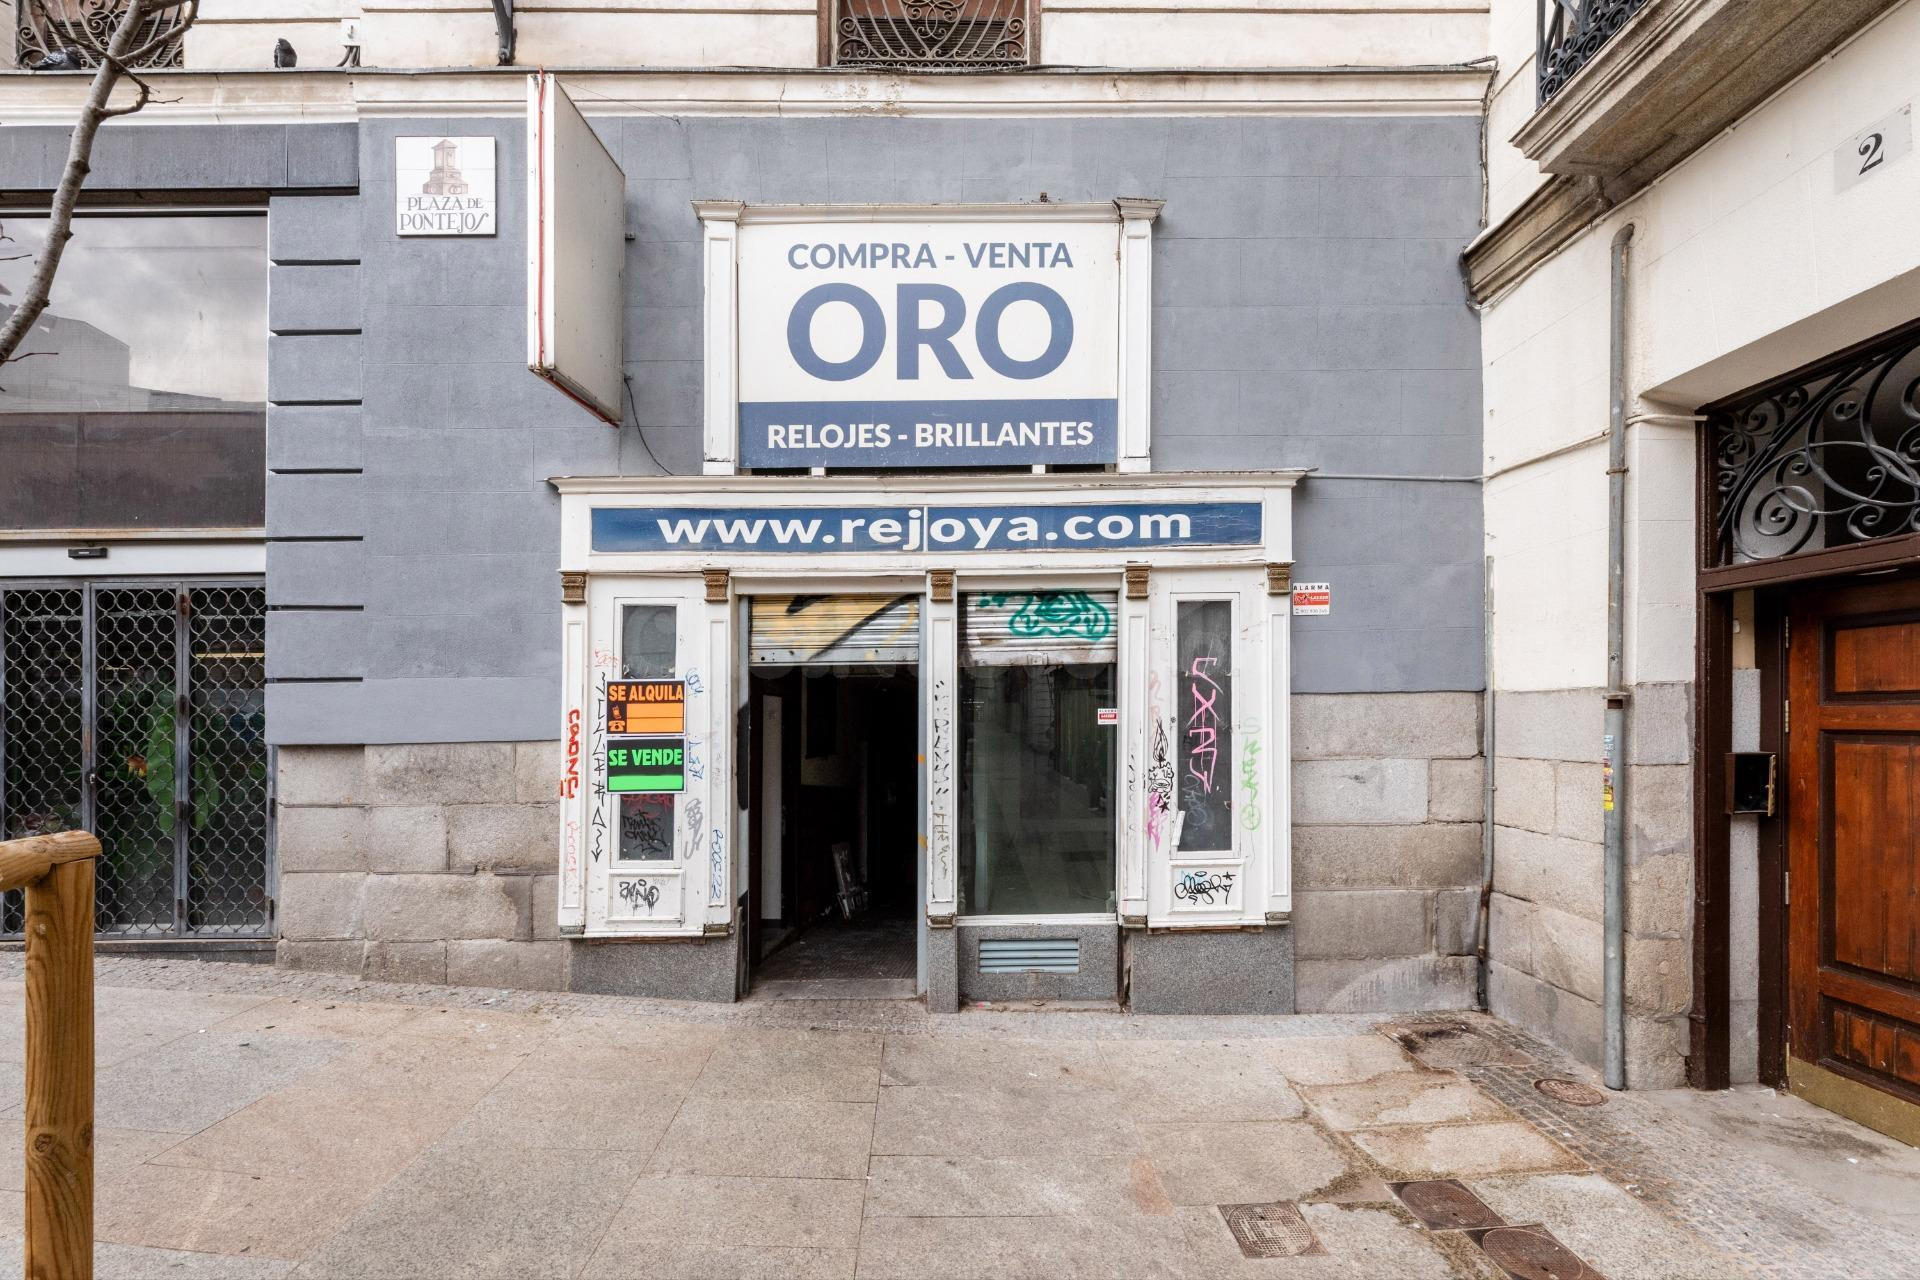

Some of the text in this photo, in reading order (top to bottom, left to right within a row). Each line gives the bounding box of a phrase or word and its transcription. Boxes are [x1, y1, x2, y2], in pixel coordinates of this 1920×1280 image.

[1858, 132, 1884, 176] 2
[407, 196, 484, 211] PLAZA DE
[399, 212, 490, 234] PONTEJOS
[787, 242, 937, 270] COMPRA
[962, 241, 1074, 269] VENTA
[786, 281, 1074, 382] ORO
[767, 423, 891, 449] RELOJES
[915, 420, 1094, 447] BRILLANTES
[656, 508, 1192, 551] www.rejoya.com
[608, 684, 684, 702] SE ALQUILA
[608, 749, 628, 767] SE
[631, 748, 683, 767] VENDE
